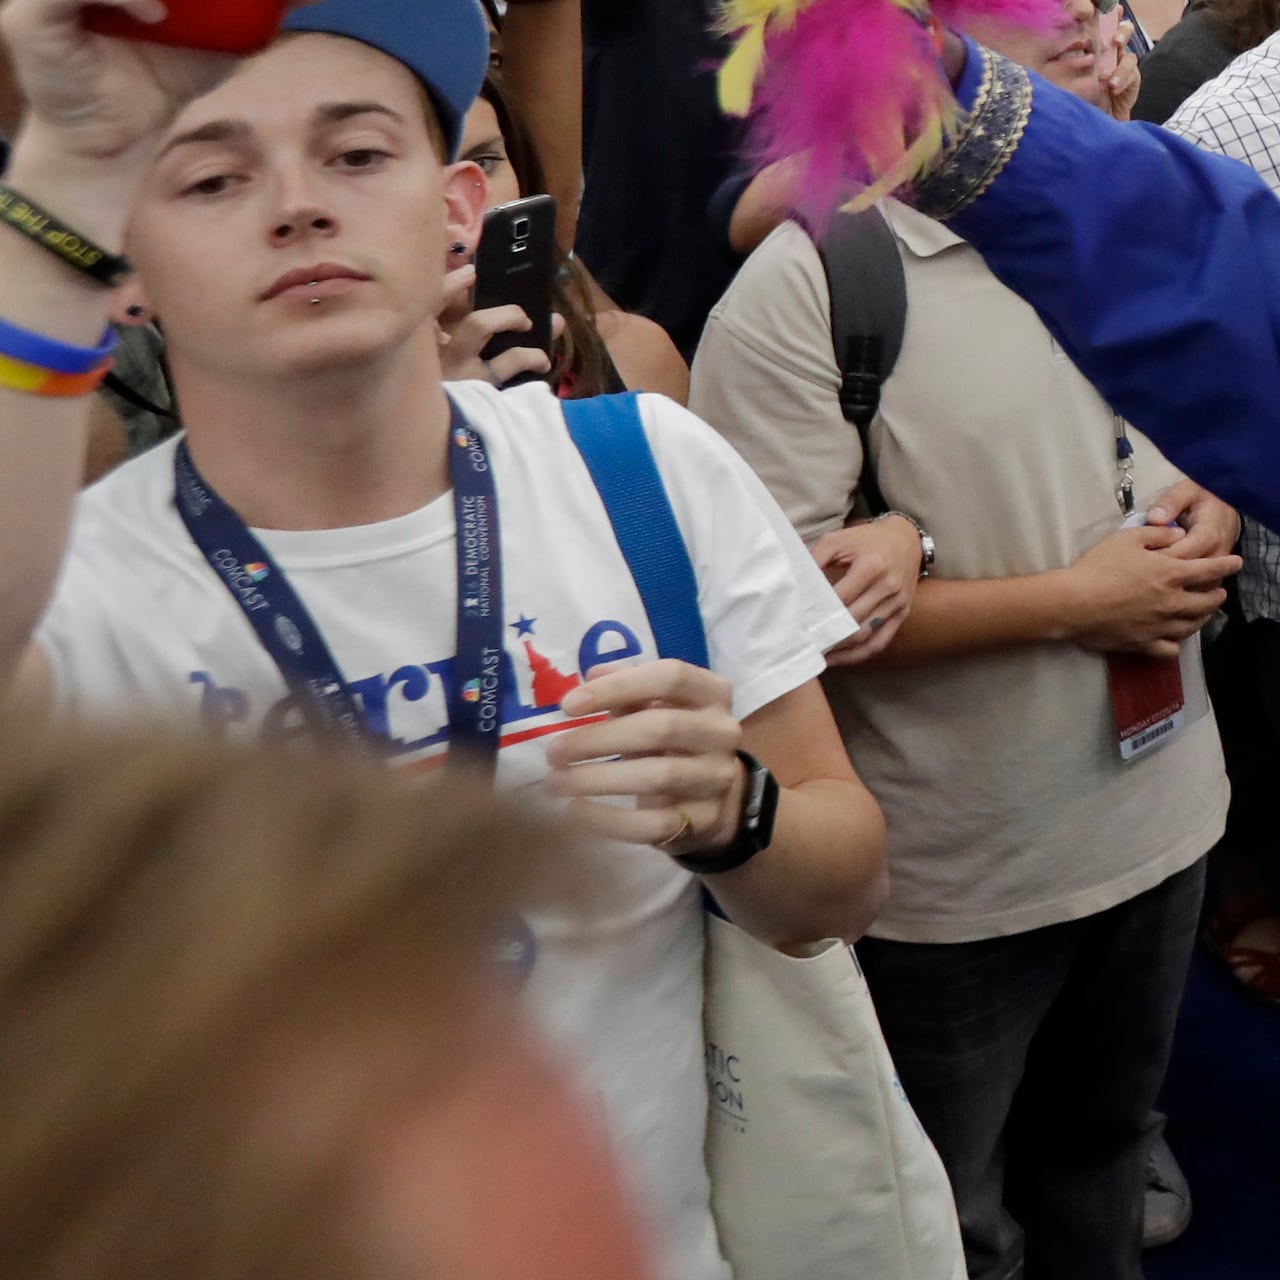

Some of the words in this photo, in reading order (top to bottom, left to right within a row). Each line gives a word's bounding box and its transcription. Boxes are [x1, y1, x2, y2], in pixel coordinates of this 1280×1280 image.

[462, 495, 479, 575] DEMOCRATIC
[477, 495, 490, 561] CONVENTION
[214, 548, 269, 613] COMCAST
[479, 566, 491, 617] NATIONAL
[479, 646, 499, 732] COMCAST
